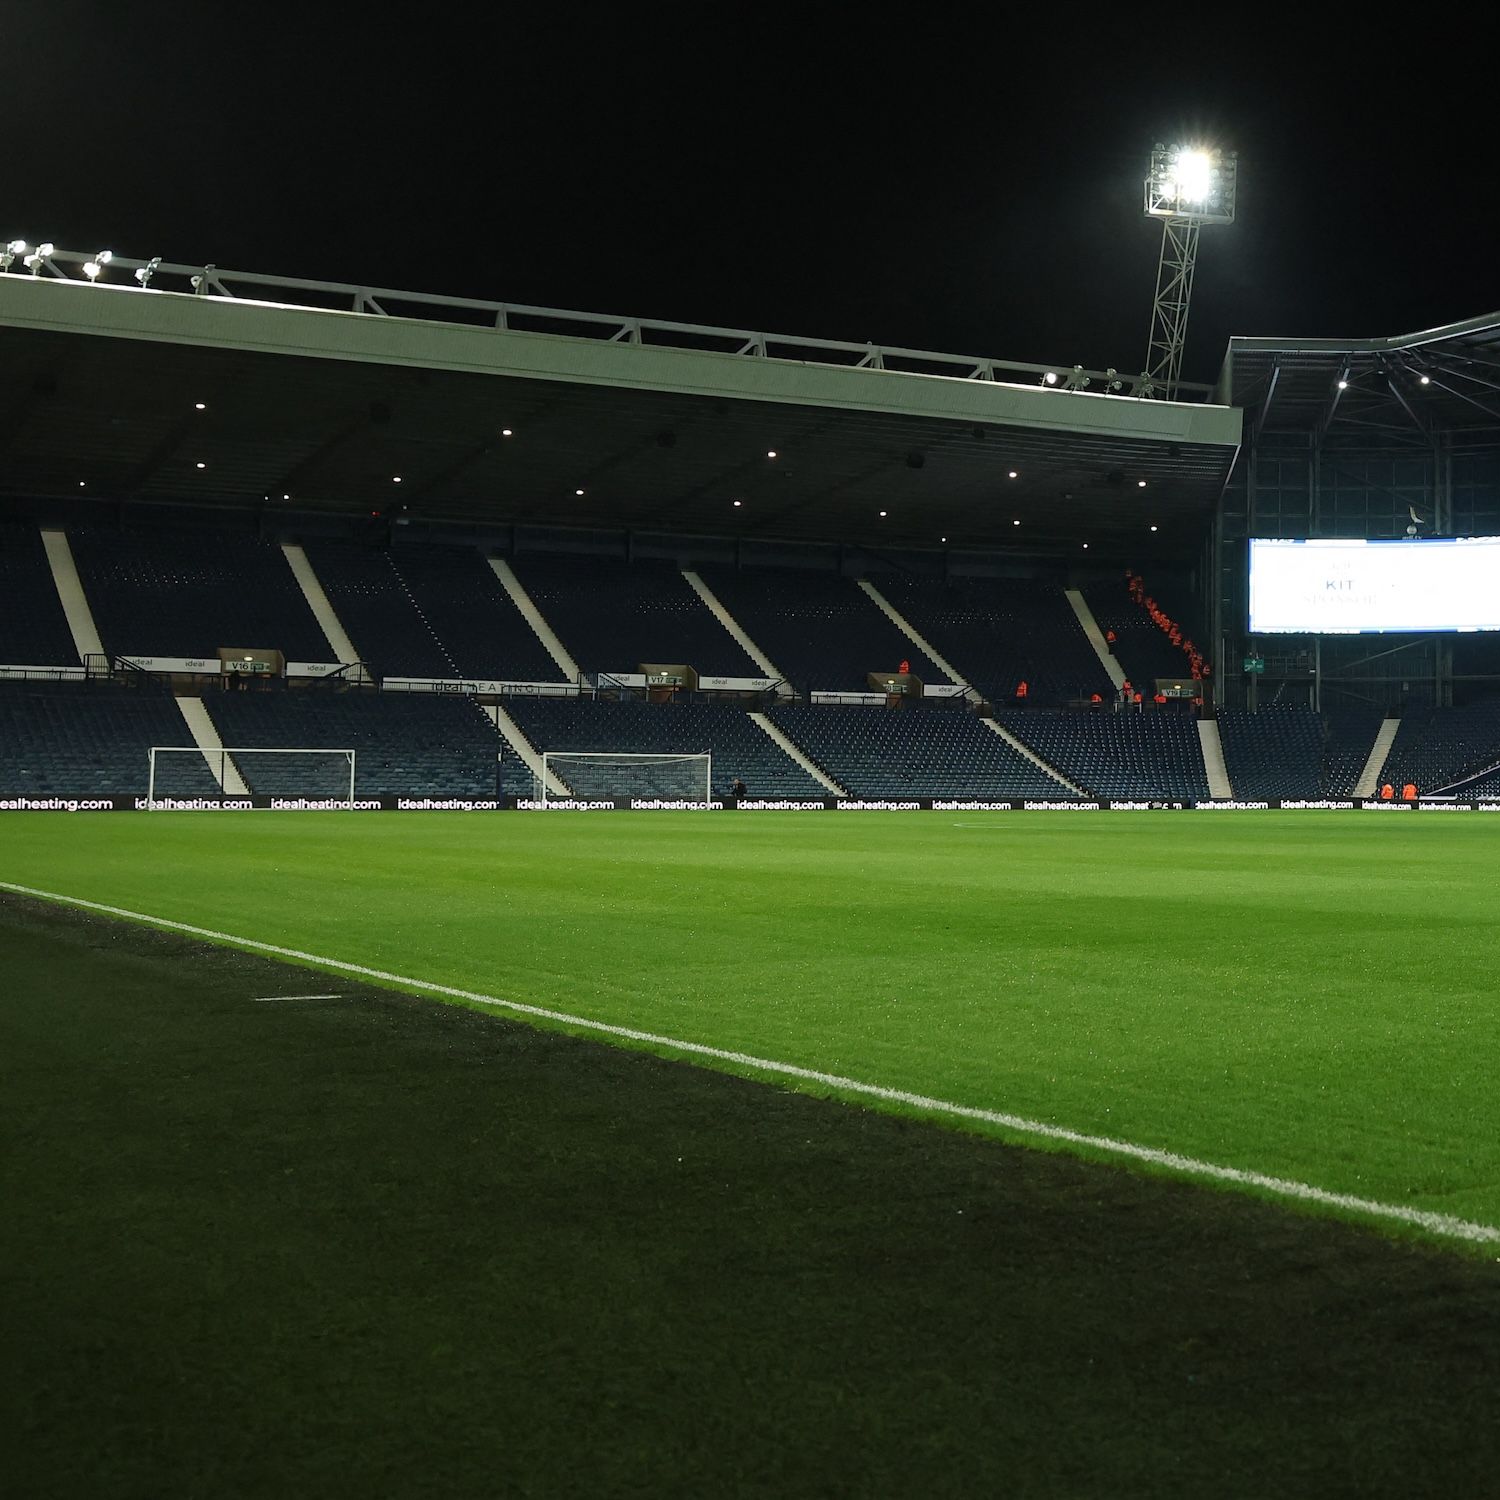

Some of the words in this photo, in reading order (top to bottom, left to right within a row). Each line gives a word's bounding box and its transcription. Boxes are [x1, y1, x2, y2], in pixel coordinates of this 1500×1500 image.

[1325, 580, 1355, 591] KIT
[232, 662, 249, 670] V16
[307, 664, 326, 672] ideal
[135, 798, 253, 809] idealheatingcom
[271, 798, 381, 809] idealheatingcom
[736, 800, 824, 811] idealheating.com
[837, 800, 920, 811] idealheating.com
[933, 800, 1011, 810] idealheating.com
[1024, 800, 1099, 810] idealheating.com
[1195, 800, 1268, 810] dealheating.com
[1280, 800, 1353, 810] idealheating.com
